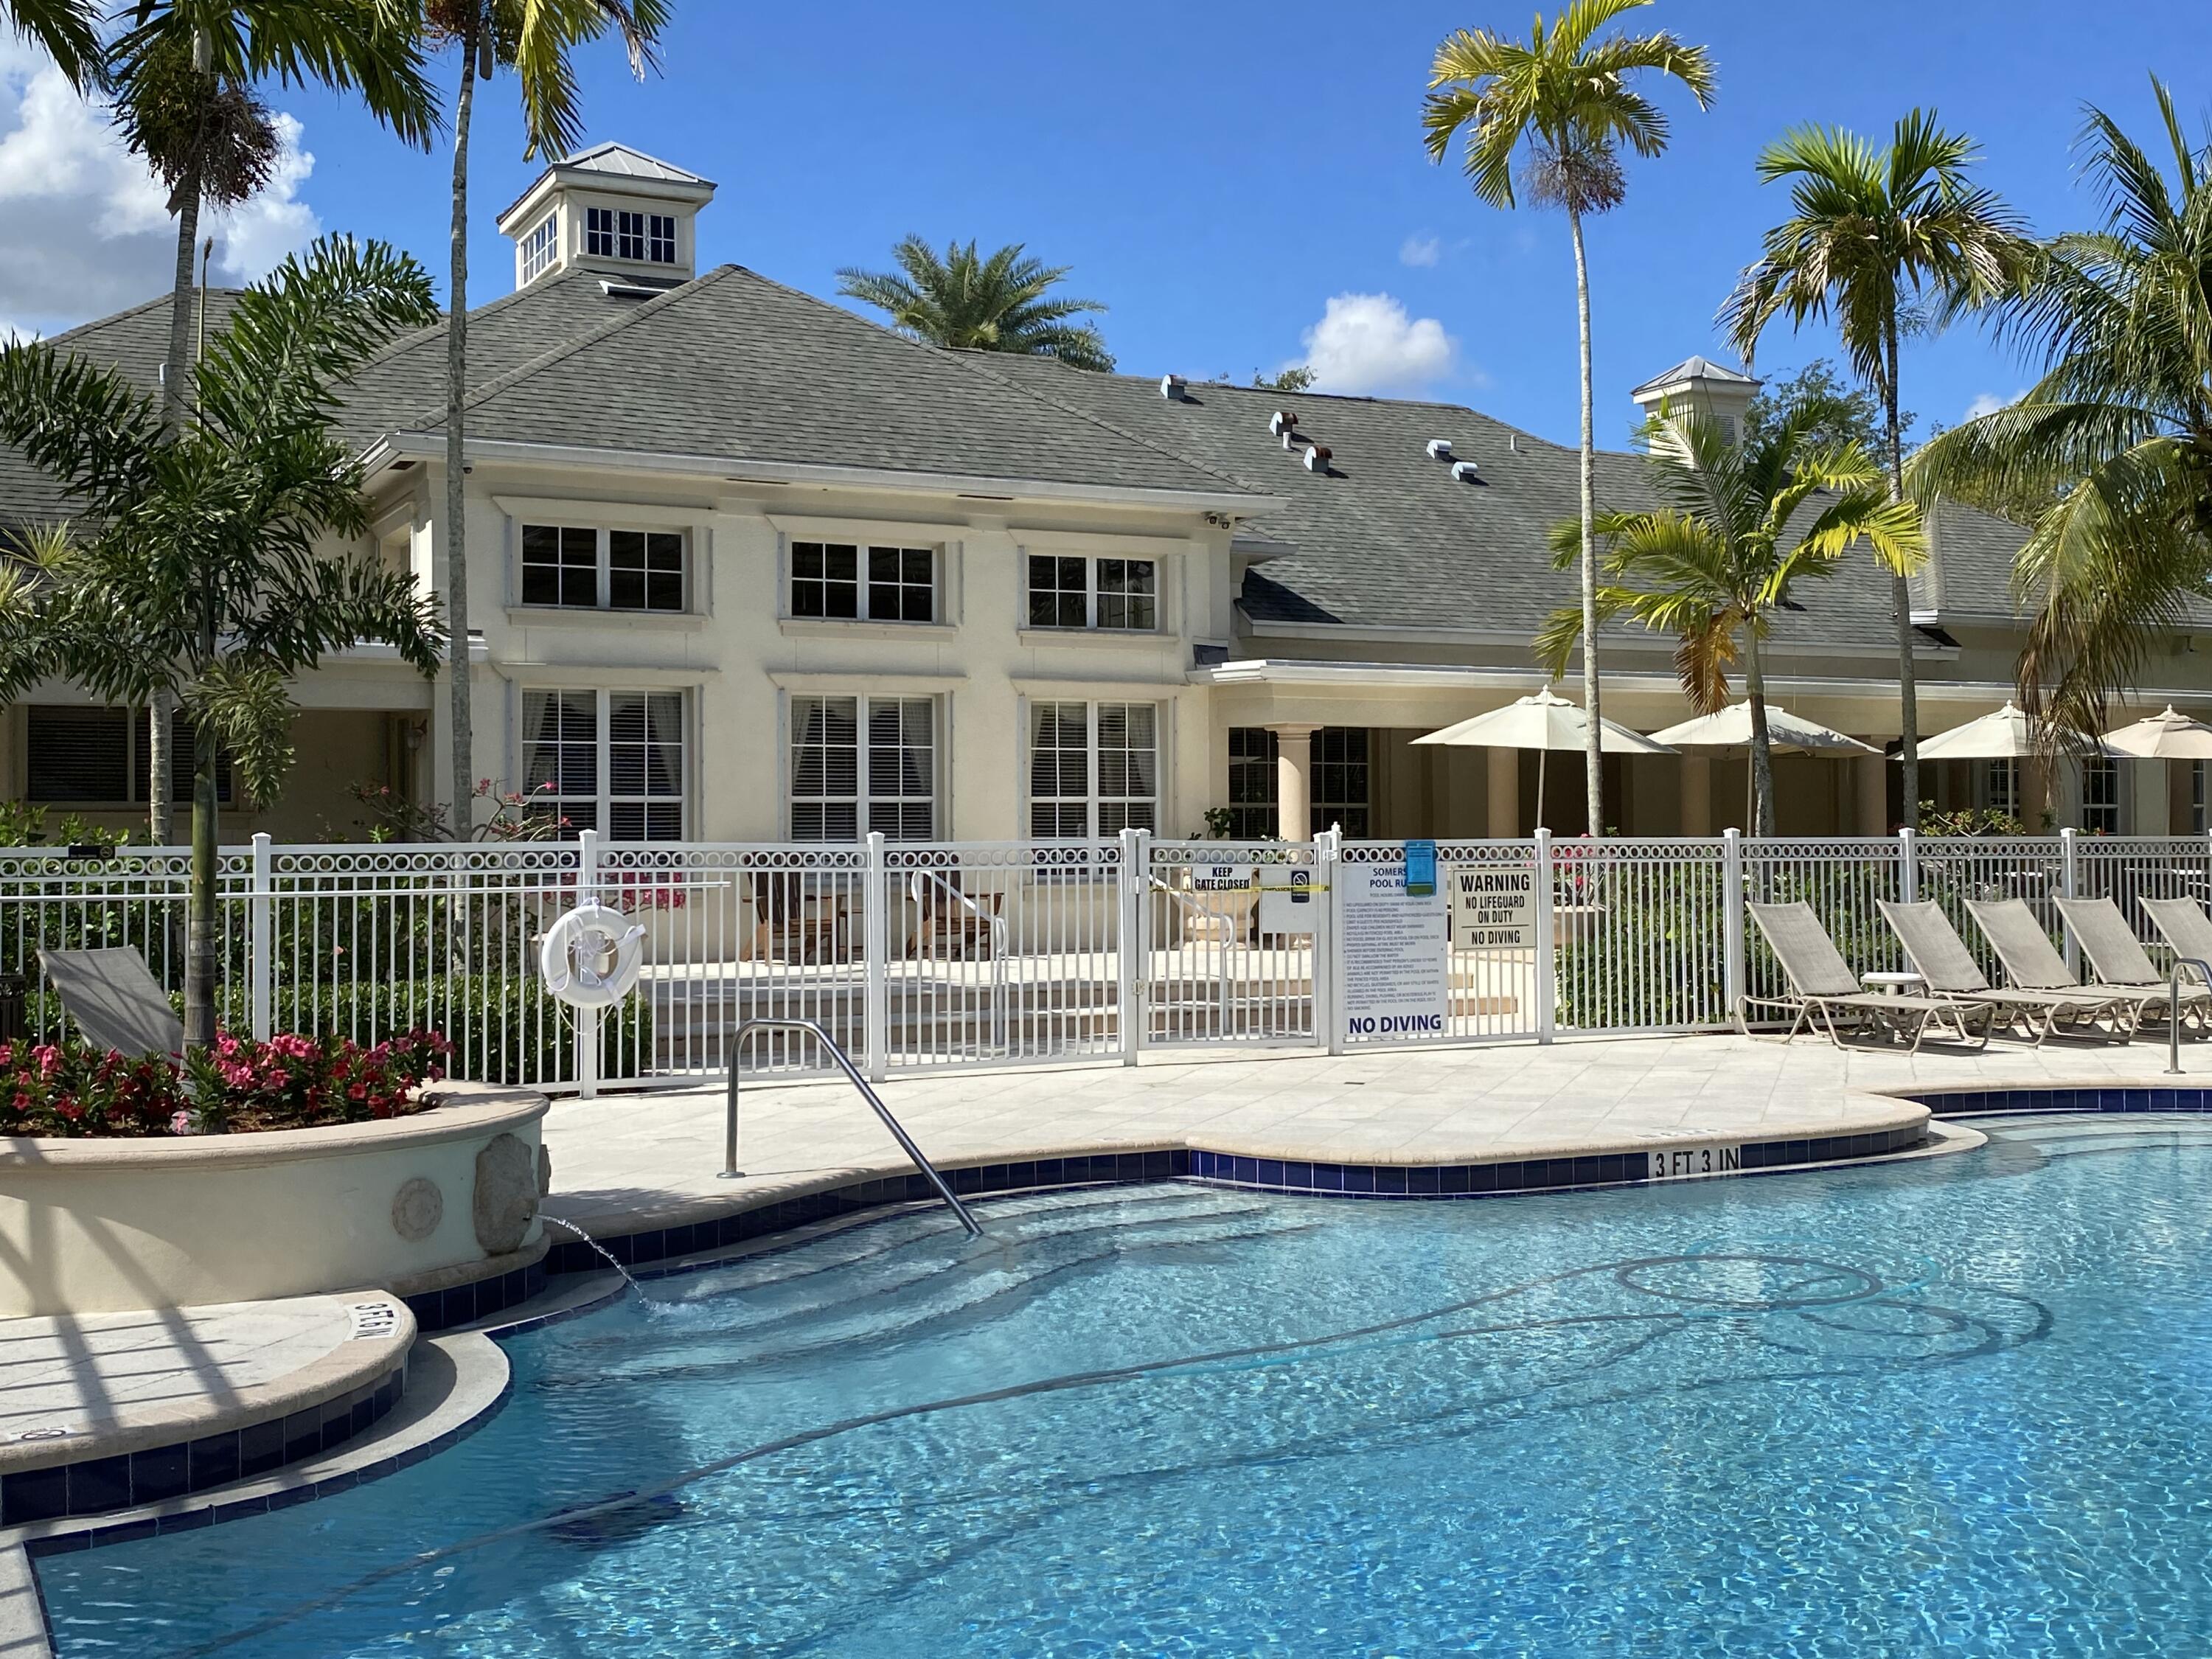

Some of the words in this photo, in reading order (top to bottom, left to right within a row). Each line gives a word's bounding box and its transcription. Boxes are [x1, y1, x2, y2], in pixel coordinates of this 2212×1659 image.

[1212, 867, 1233, 877] KEEP
[1373, 868, 1407, 877] SOMERS
[1195, 879, 1215, 890] GATE
[1217, 878, 1249, 890] CLOSED
[1370, 880, 1393, 888] POOL
[1460, 874, 1530, 892] WARNING
[1466, 897, 1477, 909] NO
[1480, 896, 1525, 908] LIFEGUARD
[1478, 911, 1489, 923] ON
[1492, 910, 1513, 923] DUTY
[1472, 931, 1484, 945] NO
[1488, 931, 1520, 944] DIVING
[1349, 1018, 1376, 1034] NO
[1380, 1014, 1441, 1032] DIVING
[1655, 1153, 1665, 1177] 3
[1673, 1151, 1694, 1175] FT
[1702, 1150, 1711, 1172] 3
[1719, 1147, 1739, 1171] IN
